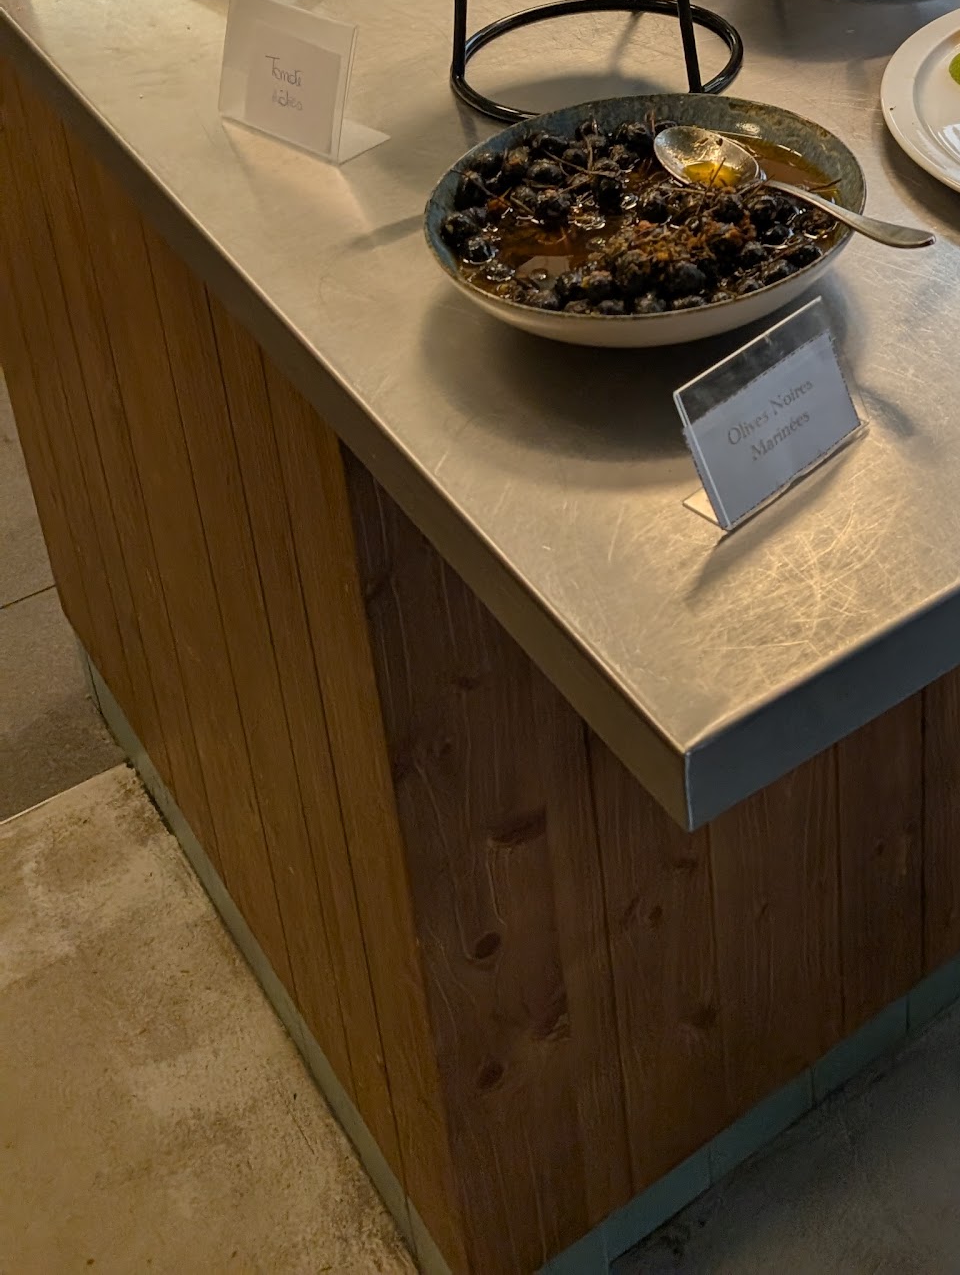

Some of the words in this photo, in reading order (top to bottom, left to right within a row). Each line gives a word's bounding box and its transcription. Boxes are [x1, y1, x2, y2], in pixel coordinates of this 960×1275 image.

[728, 411, 769, 445] Olives
[769, 380, 812, 415] Noires
[751, 411, 810, 460] Marinées
